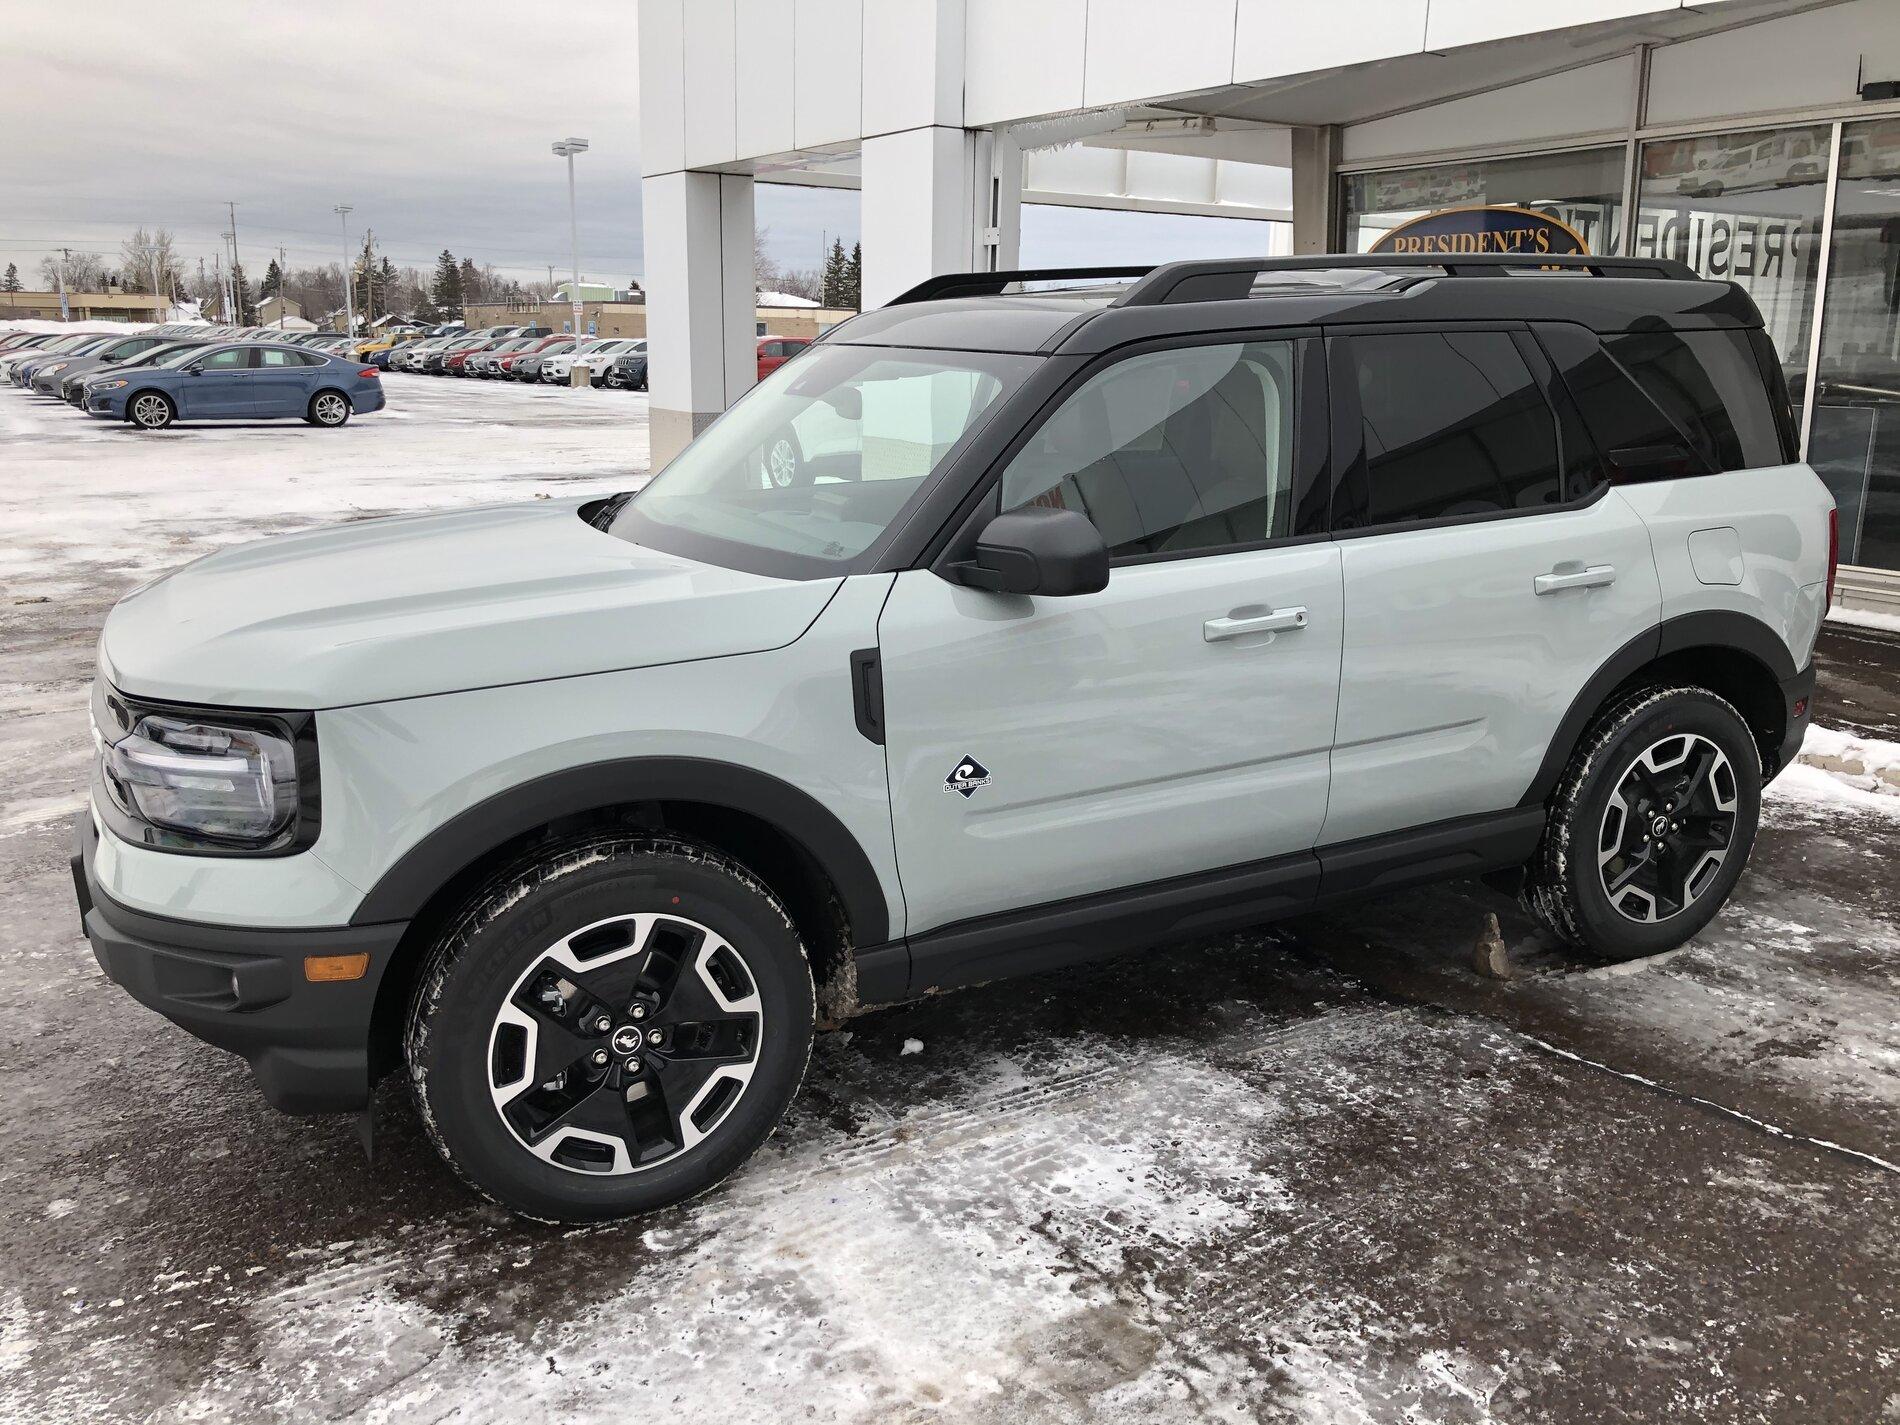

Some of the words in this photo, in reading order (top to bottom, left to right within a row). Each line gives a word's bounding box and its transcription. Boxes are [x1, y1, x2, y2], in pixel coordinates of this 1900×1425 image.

[1393, 227, 1550, 254] PRESIDENT'S
[945, 782, 967, 791] OUTER
[968, 778, 992, 788] BANKS
